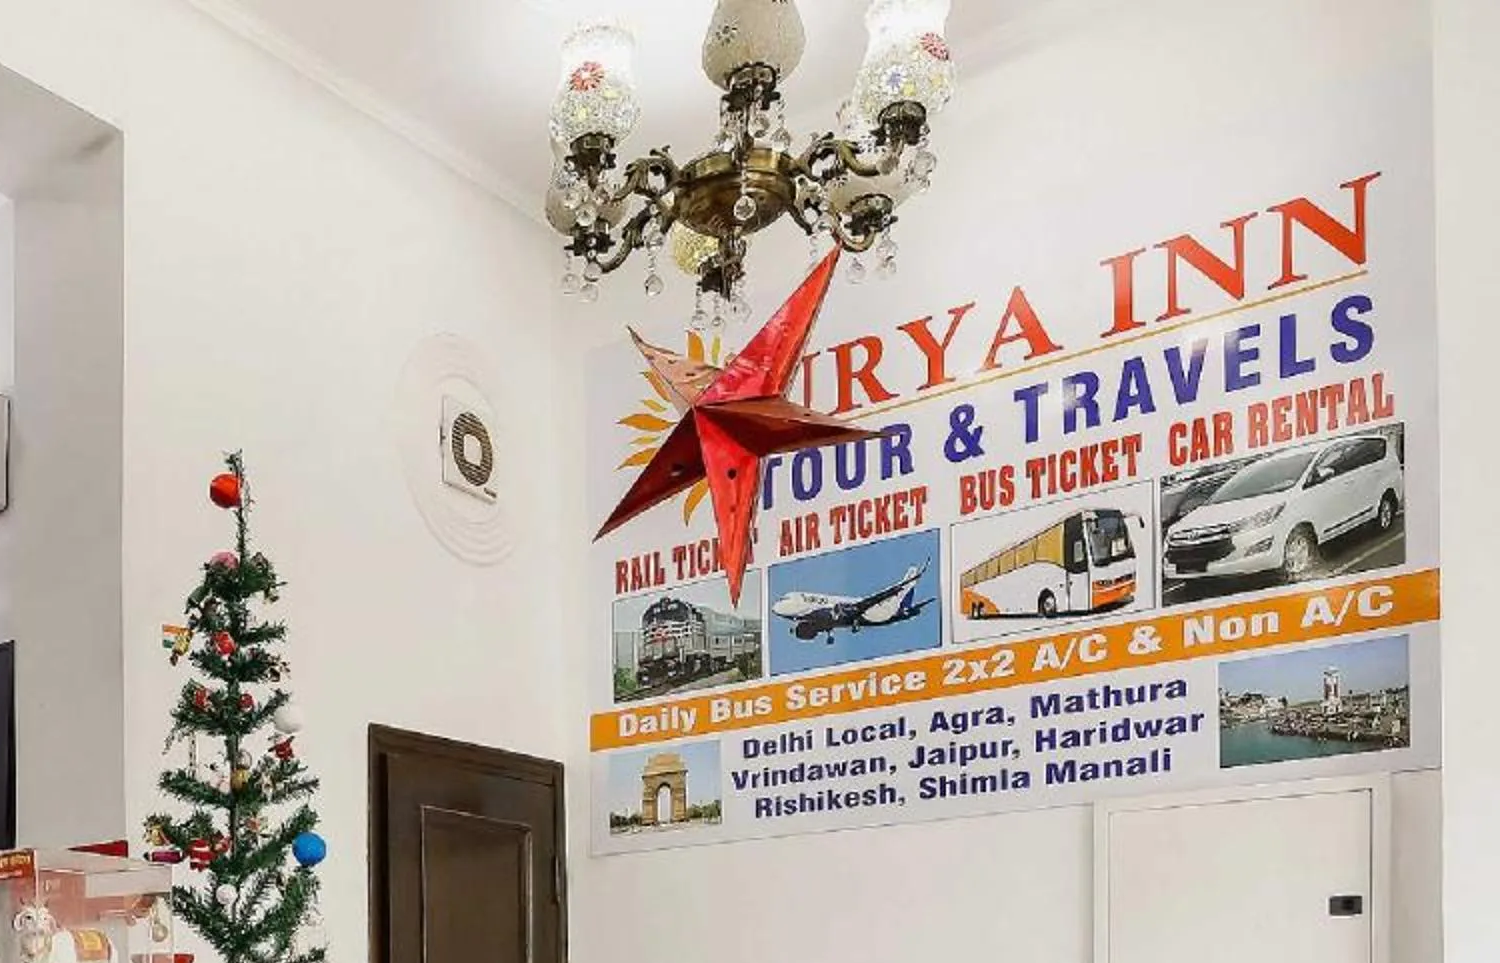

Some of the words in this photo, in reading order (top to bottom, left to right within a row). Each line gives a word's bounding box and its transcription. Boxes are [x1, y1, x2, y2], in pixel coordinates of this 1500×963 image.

[1101, 172, 1381, 338] INN
[762, 423, 915, 511] TOUR
[943, 404, 985, 463] &
[1014, 295, 1375, 444] TRAVELS
[615, 551, 665, 595] RAIL
[780, 512, 821, 557] AIR
[829, 486, 928, 545] TICKET
[959, 465, 1016, 515] BUS
[1026, 434, 1143, 500] TICKET
[1168, 411, 1234, 467] CAR
[1247, 373, 1394, 449] RENTAL
[618, 706, 698, 738] Daily
[711, 698, 773, 724] Bus
[787, 667, 927, 711] Service
[942, 649, 1016, 687] 2x2
[1032, 632, 1108, 673] A/C
[1128, 625, 1163, 656] &
[1183, 608, 1280, 648] Non
[1301, 586, 1394, 630] A/C
[743, 729, 814, 759] Delhi
[826, 717, 918, 748] Local,
[929, 706, 1016, 740] Agra,
[1030, 676, 1188, 720] Mathura
[731, 754, 898, 791] Vrindawan,
[908, 738, 1021, 770] Jaipur,
[1035, 709, 1206, 753] Haridwar
[755, 782, 906, 819] Rishikesh,
[919, 768, 1031, 801] Shimla
[1046, 748, 1173, 786] Manali
